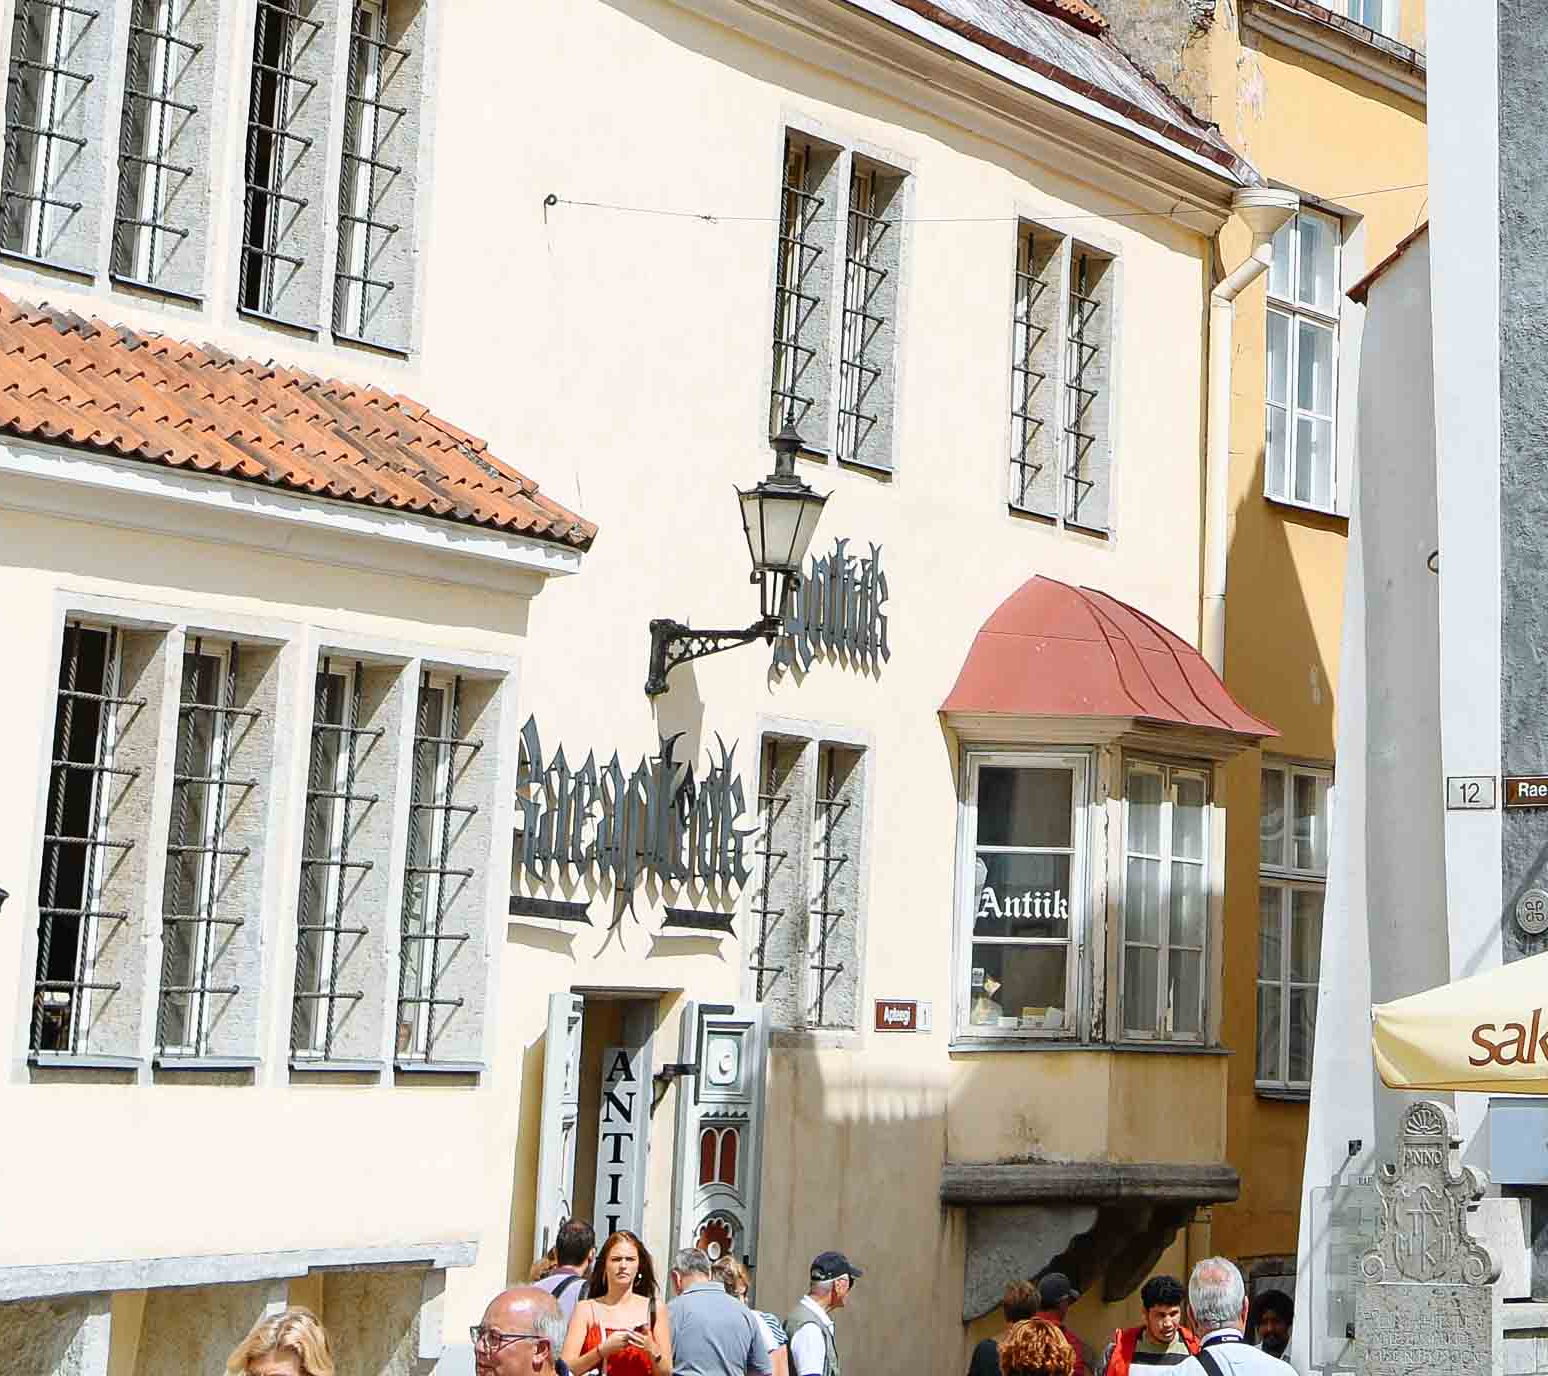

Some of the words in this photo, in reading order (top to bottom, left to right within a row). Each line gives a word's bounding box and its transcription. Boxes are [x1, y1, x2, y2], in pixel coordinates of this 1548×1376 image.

[1459, 783, 1481, 803] 12
[977, 886, 1069, 920] Antiik
[602, 1051, 637, 1236] ANTII
[1403, 1150, 1443, 1166] ANNO
